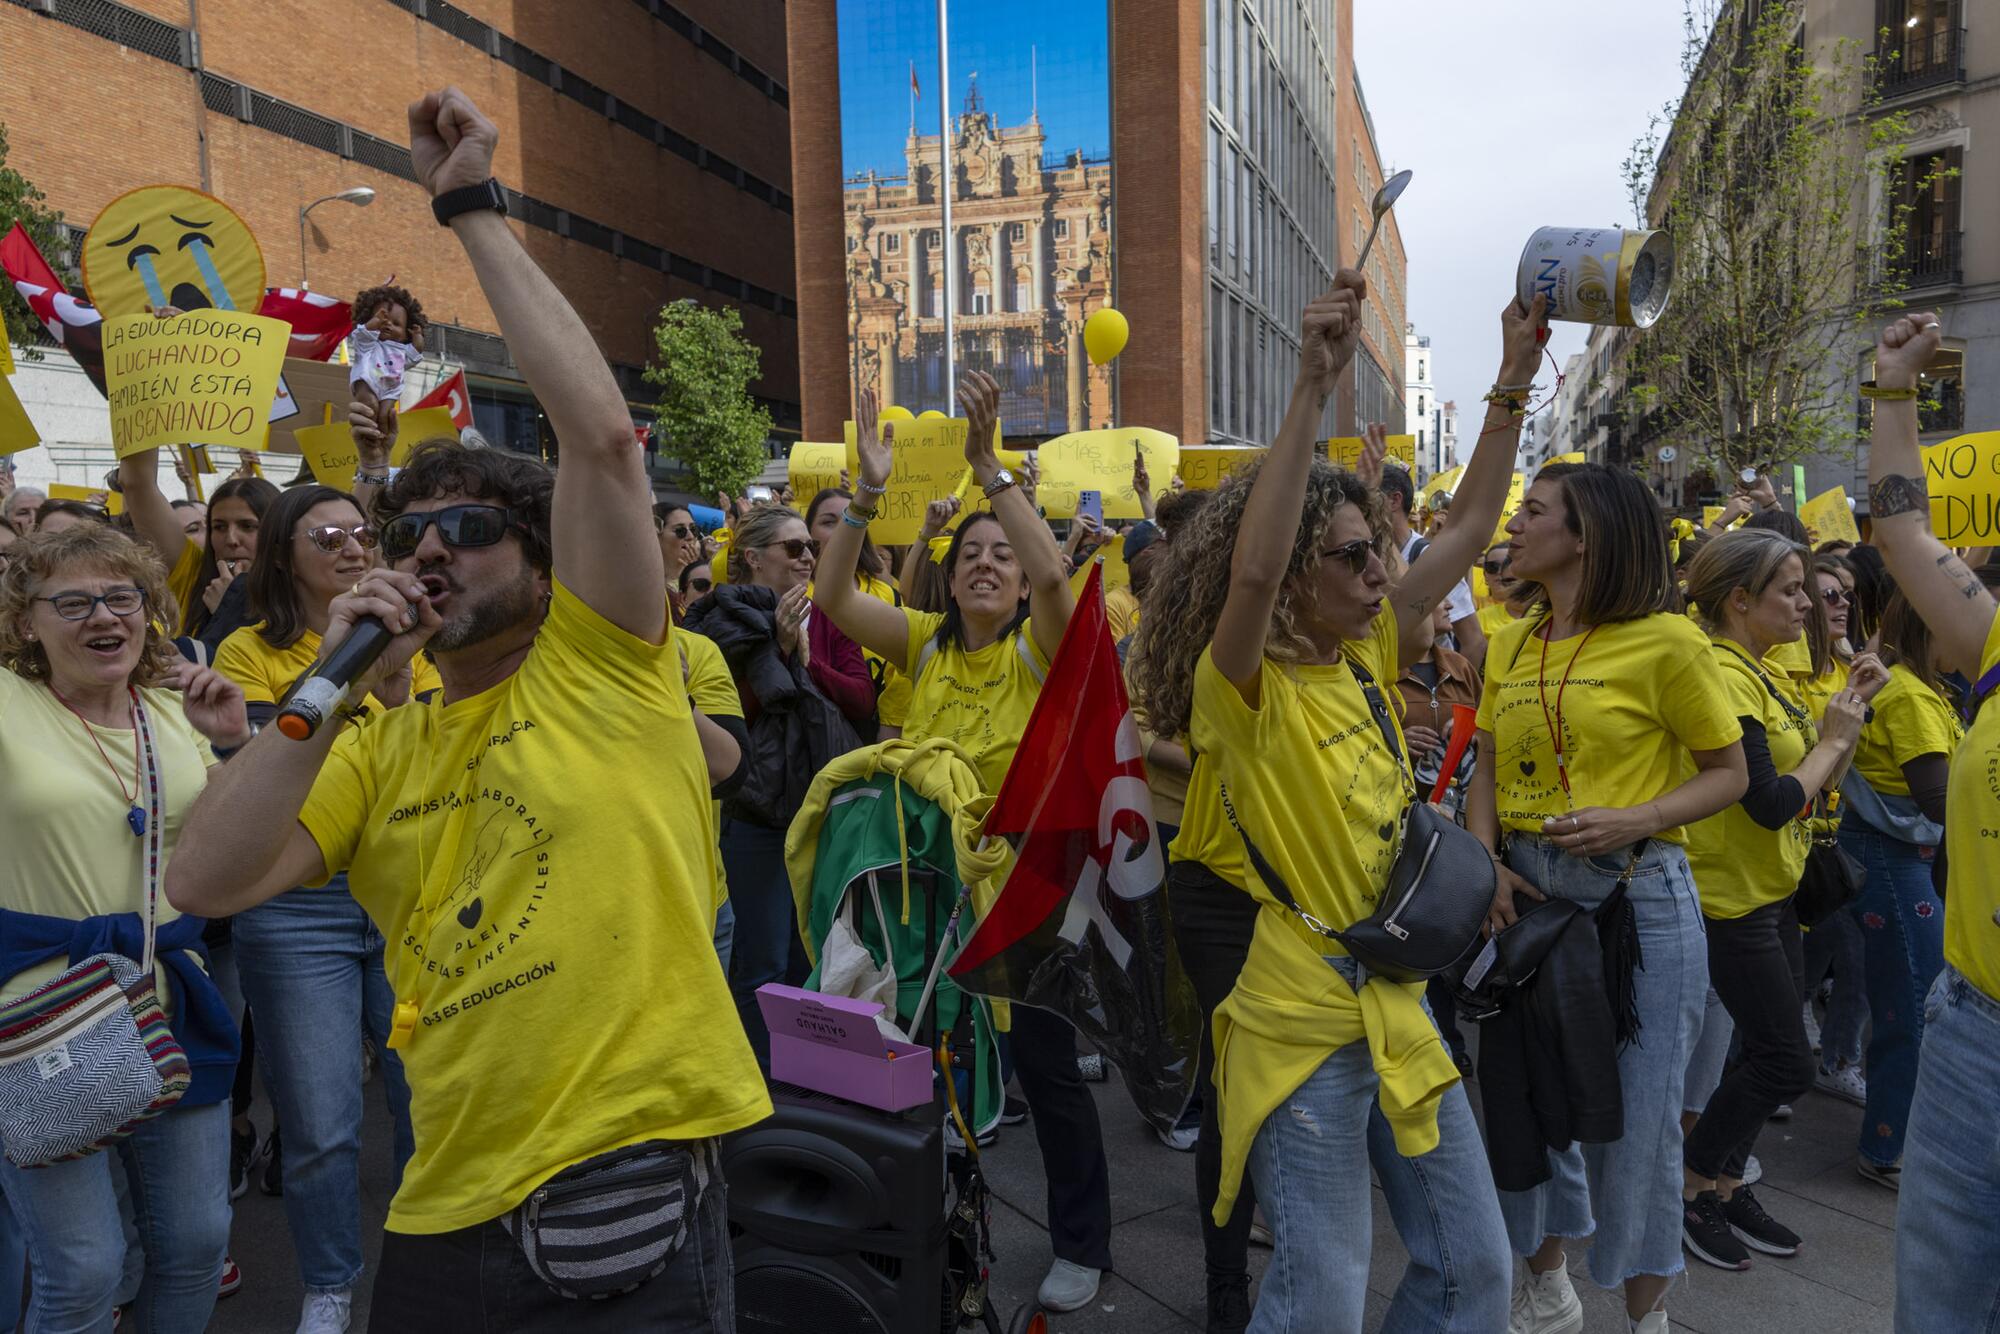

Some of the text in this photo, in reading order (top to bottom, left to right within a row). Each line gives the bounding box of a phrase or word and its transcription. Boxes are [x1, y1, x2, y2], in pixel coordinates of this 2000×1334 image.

[106, 318, 262, 349] LA EDUCADORA
[116, 344, 241, 376] LUCHANDO
[109, 374, 252, 413] TAMBIÉN ESTÁ
[115, 400, 254, 450] ENSEÑANDO
[1926, 444, 1977, 479] NO
[1564, 678, 1605, 689] NFANCIA
[478, 788, 545, 840] ABORAL
[1981, 828, 2000, 840] 0-3
[477, 852, 549, 970] INFANTILES
[455, 924, 500, 954] PLEI
[422, 960, 557, 1028] 0-3 ES EDUCACIÓN
[796, 1018, 848, 1038] GALHAUD
